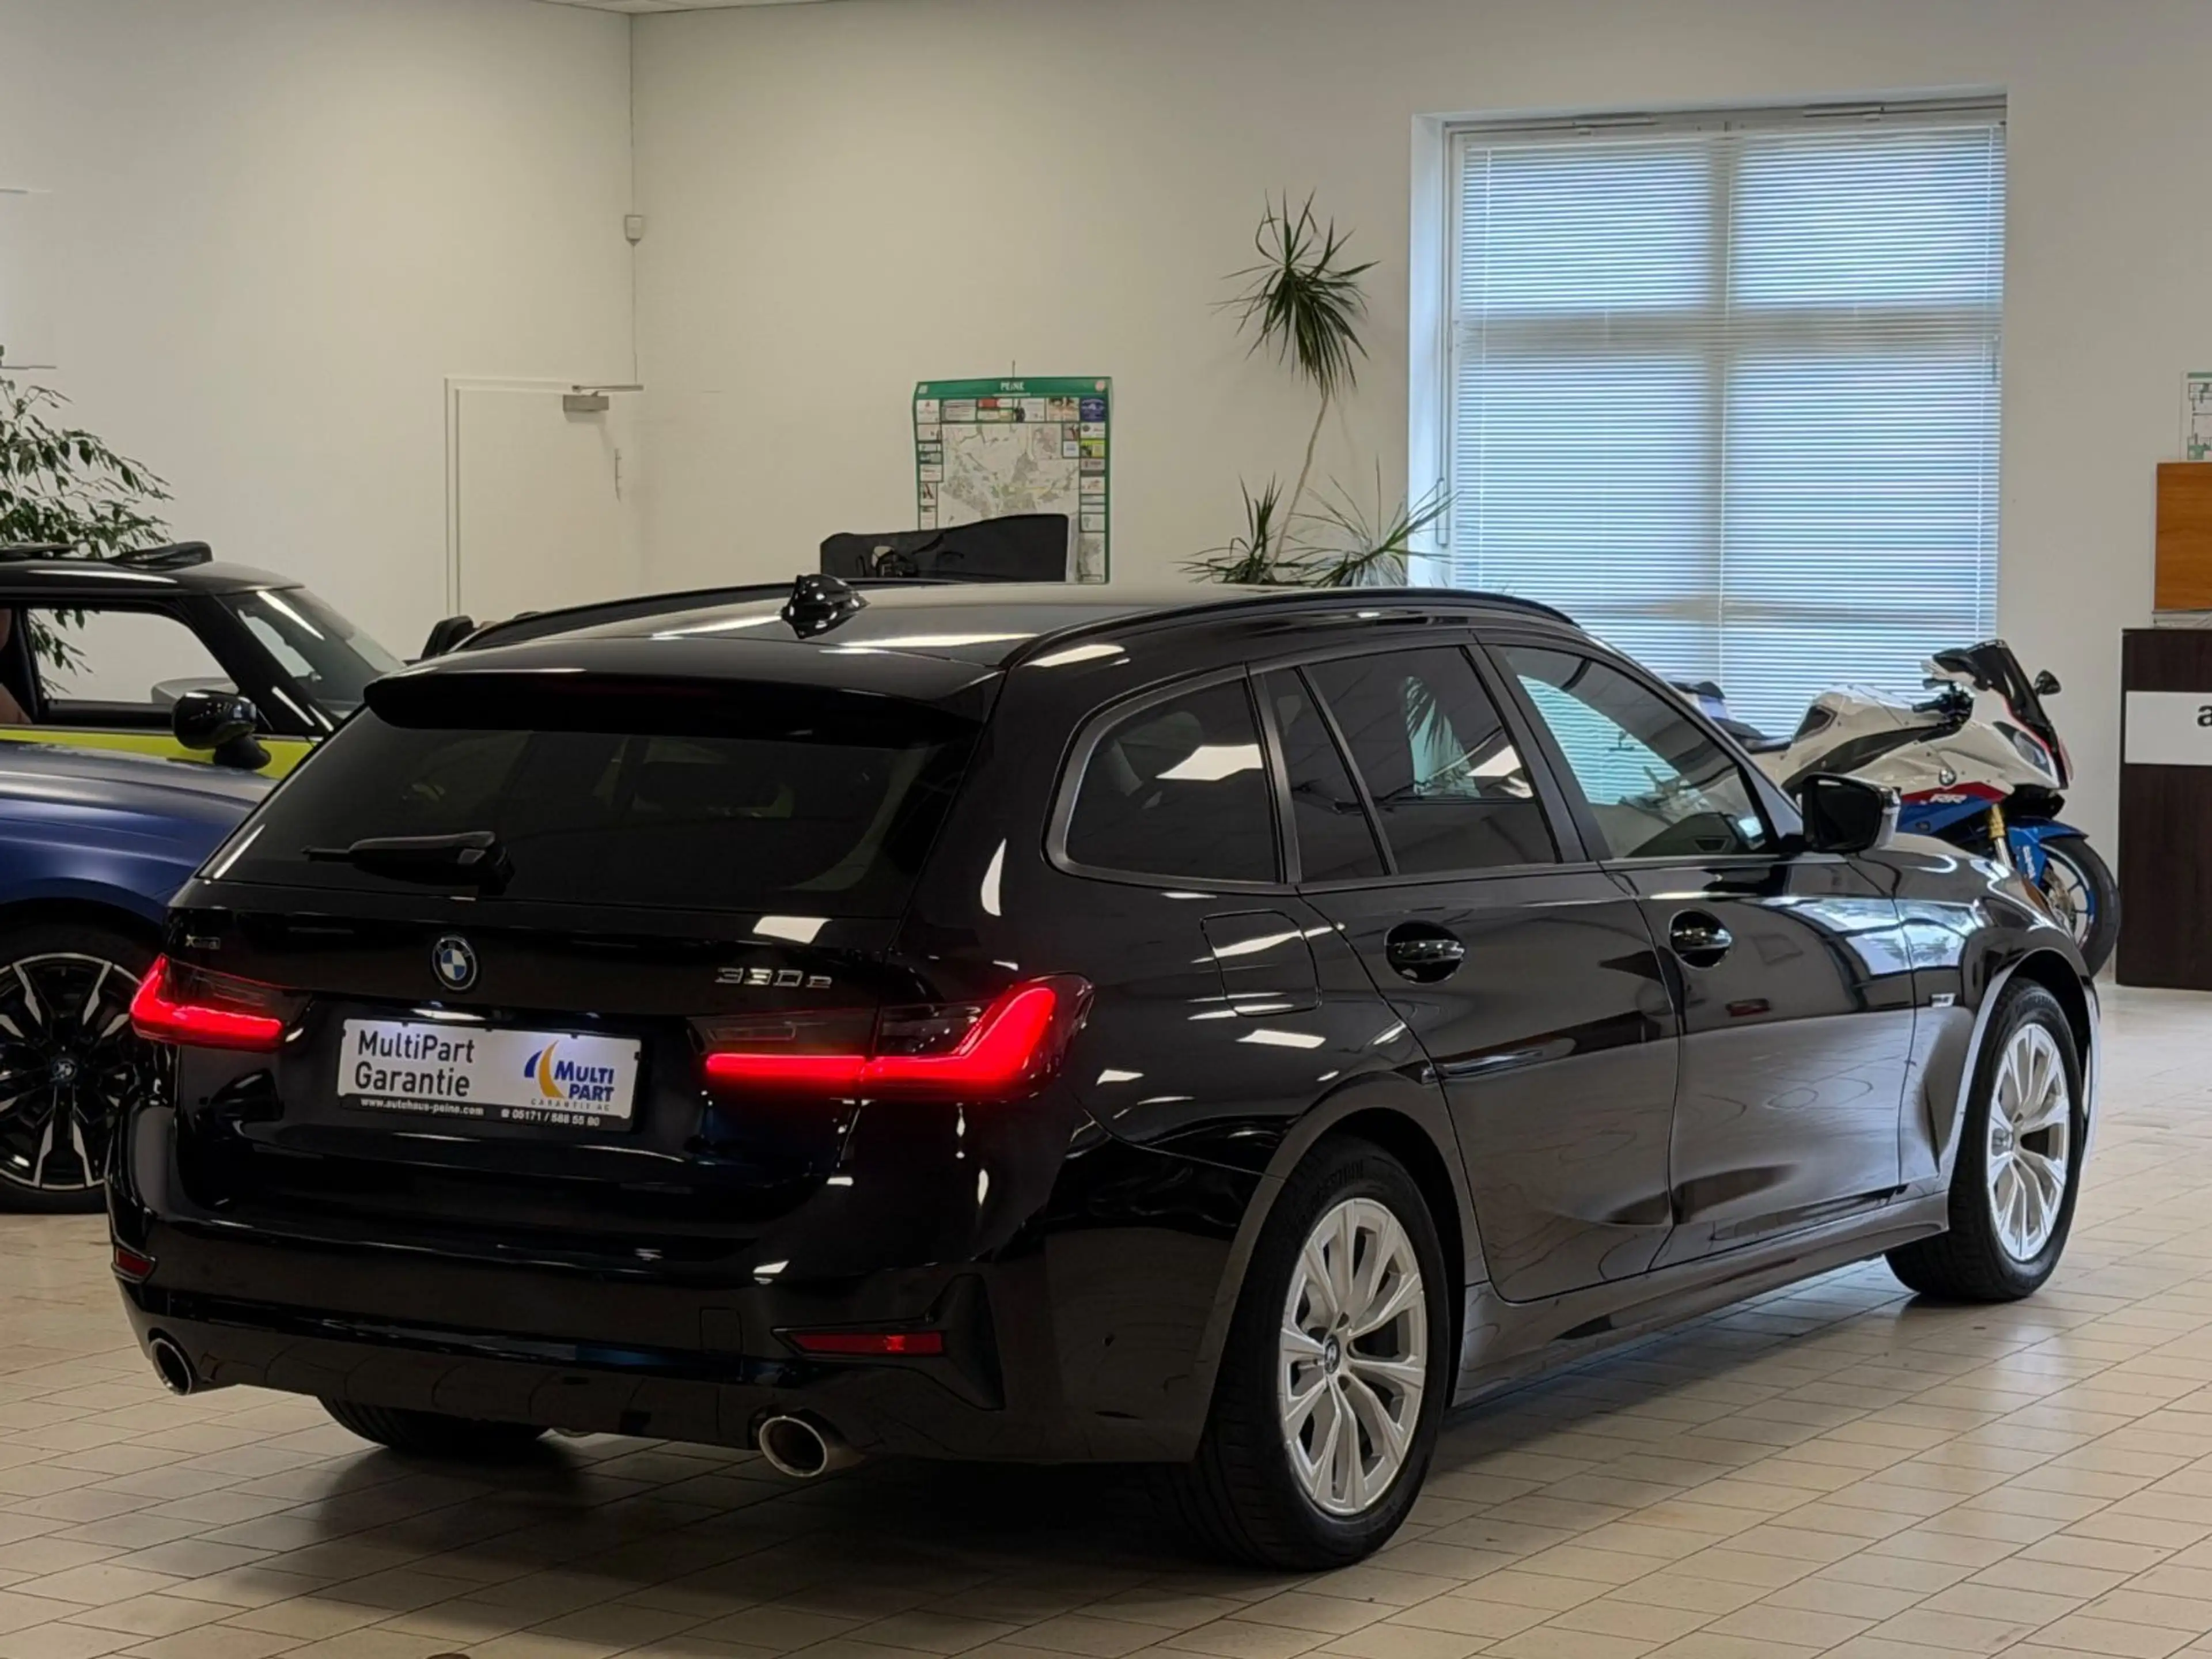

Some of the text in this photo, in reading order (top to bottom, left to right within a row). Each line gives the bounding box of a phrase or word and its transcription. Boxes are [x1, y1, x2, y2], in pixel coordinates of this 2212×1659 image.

[358, 1029, 475, 1063] MultiPart
[355, 1060, 470, 1097] Garantie
[554, 1060, 615, 1084] MULTI
[569, 1084, 615, 1102] PART
